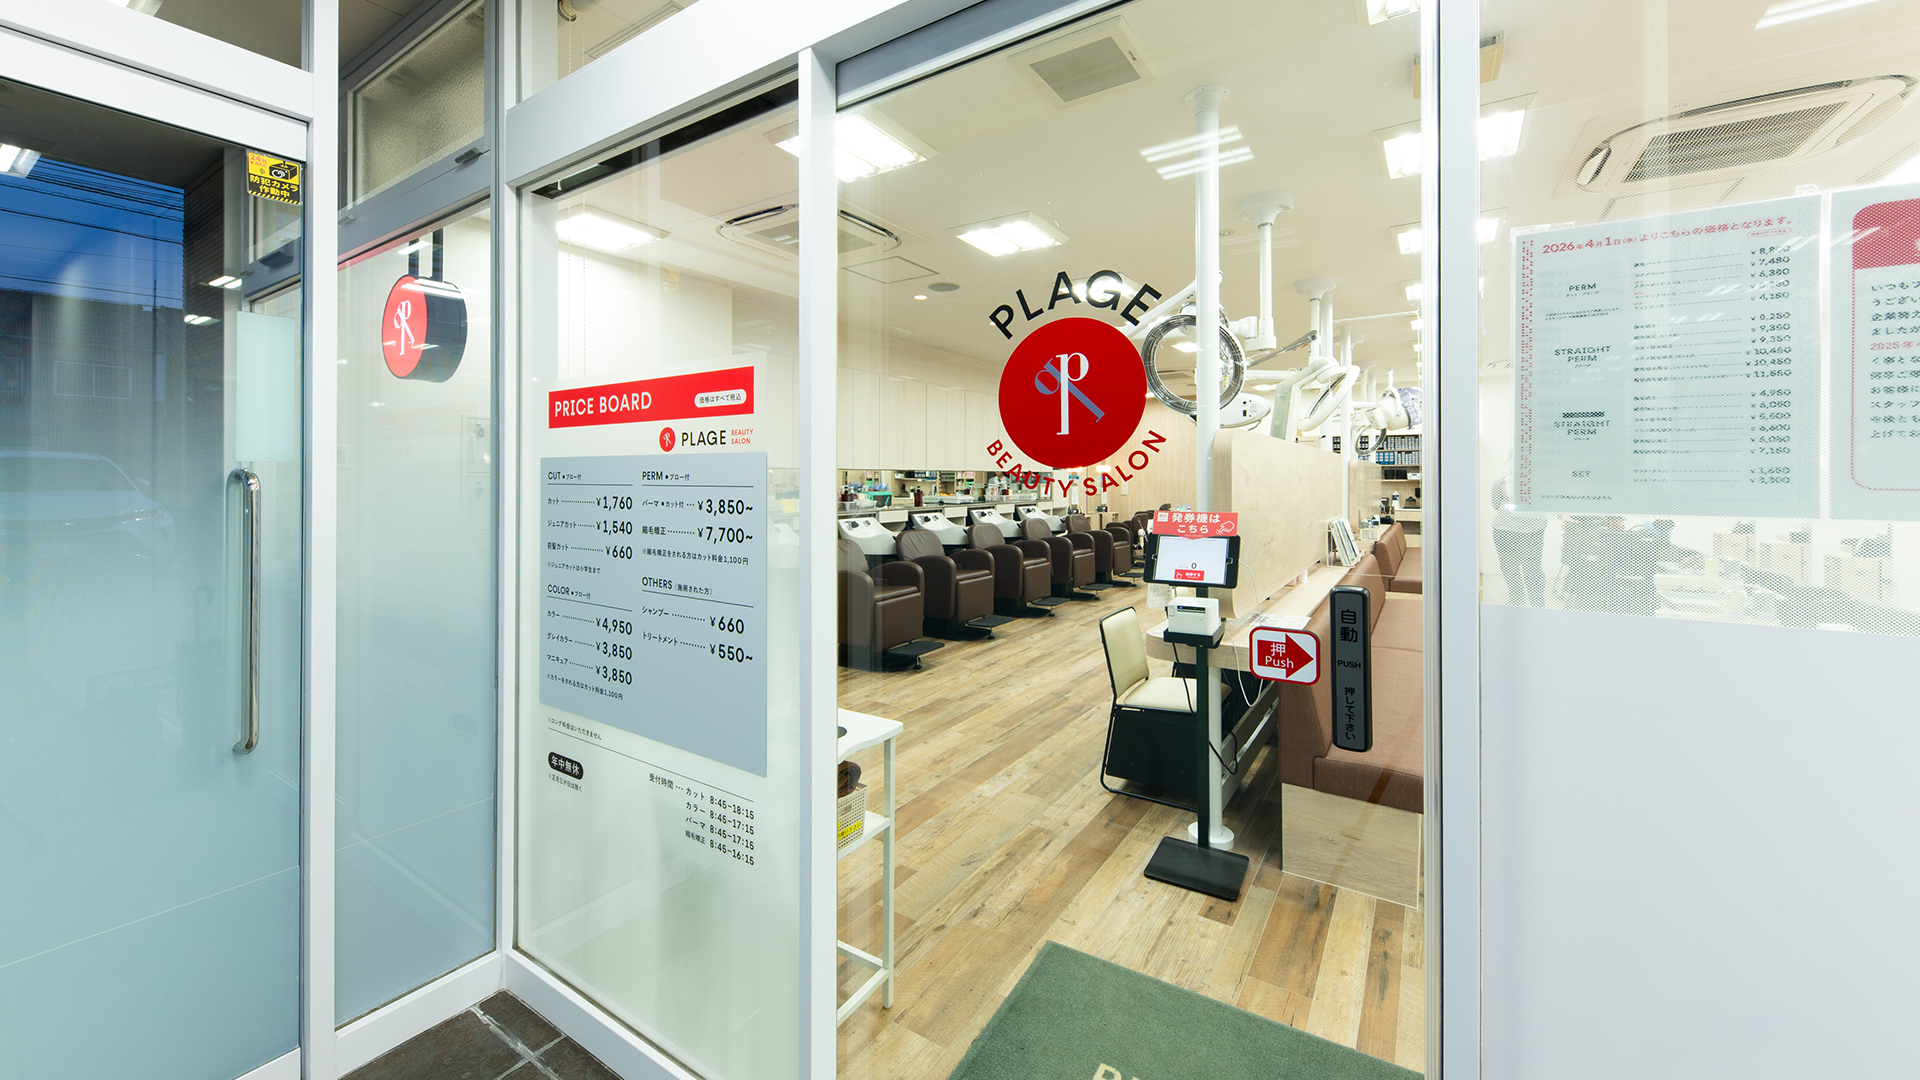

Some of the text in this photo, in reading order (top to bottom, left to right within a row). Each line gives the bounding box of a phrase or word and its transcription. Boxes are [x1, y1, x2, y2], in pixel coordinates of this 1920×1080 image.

[250, 174, 298, 192] 防犯カメラ
[259, 185, 290, 198] 作動中
[988, 269, 1163, 340] PLAGE
[555, 391, 652, 418] PRICE BOARD
[682, 430, 726, 446] PLAGE
[731, 428, 754, 436] BEAUTY
[986, 430, 1168, 498] BEAUTY SALON
[548, 472, 561, 480] CUT
[642, 471, 663, 480] PERM
[596, 496, 633, 511] ¥1,760
[1172, 512, 1220, 524] 発券機は
[596, 520, 633, 536] ¥1,540
[1178, 524, 1209, 534] こちら
[606, 545, 633, 560] ¥660
[547, 584, 570, 595] COLOR
[642, 576, 673, 589] OTHERS
[596, 617, 633, 635] ¥4,950
[710, 616, 745, 634] ¥660
[1340, 608, 1358, 643] 自動
[596, 641, 633, 660] ¥3,850
[1270, 642, 1286, 657] 押
[1265, 656, 1294, 669] Push
[1338, 660, 1361, 669] PUSH
[596, 666, 633, 685] ¥3,850
[1344, 686, 1356, 740] 押して下さい
[552, 755, 580, 776] 年中無休
